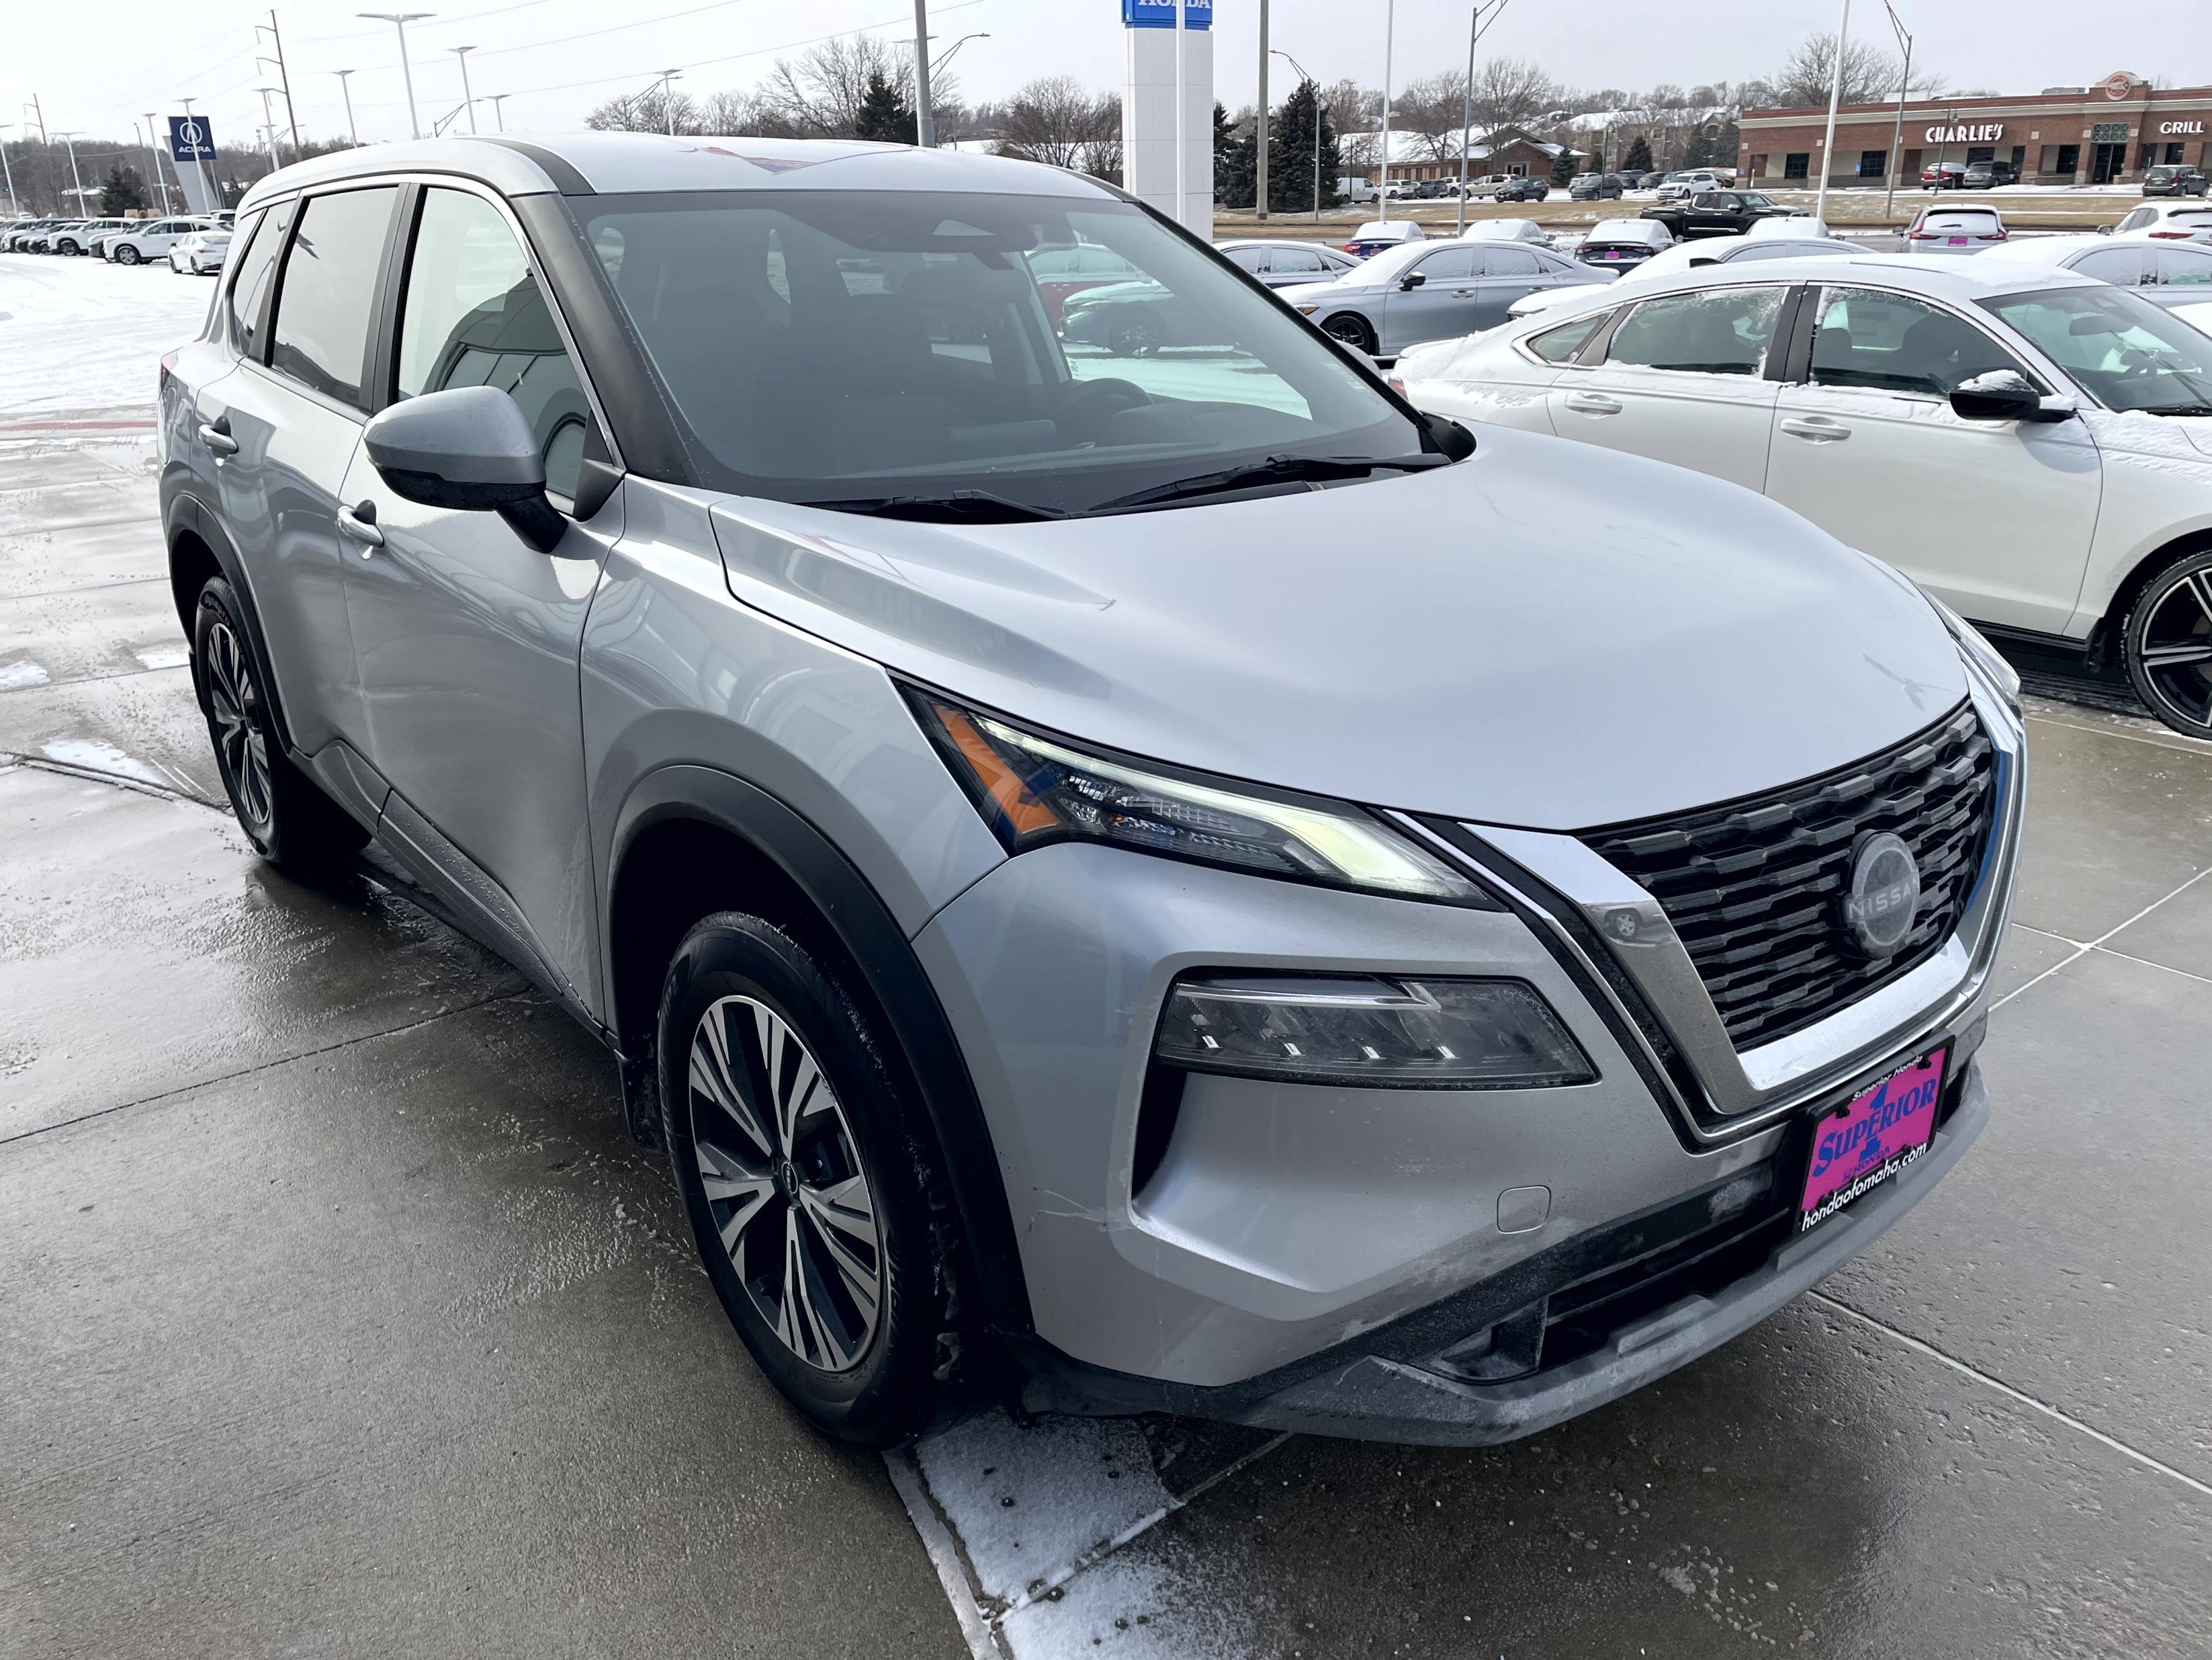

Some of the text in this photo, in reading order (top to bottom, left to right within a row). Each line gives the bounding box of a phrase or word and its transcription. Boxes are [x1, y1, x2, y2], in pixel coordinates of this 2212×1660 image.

[1138, 0, 1211, 8] HODA
[1926, 124, 2003, 142] CHARLIE'S
[2160, 121, 2205, 133] GRILL
[1848, 878, 1920, 919] NISSAN
[1852, 1055, 1923, 1101] Superior Honda
[1812, 1078, 1938, 1177] SUPERIOR
[1801, 1142, 1927, 1231] hondaofomaha.com
